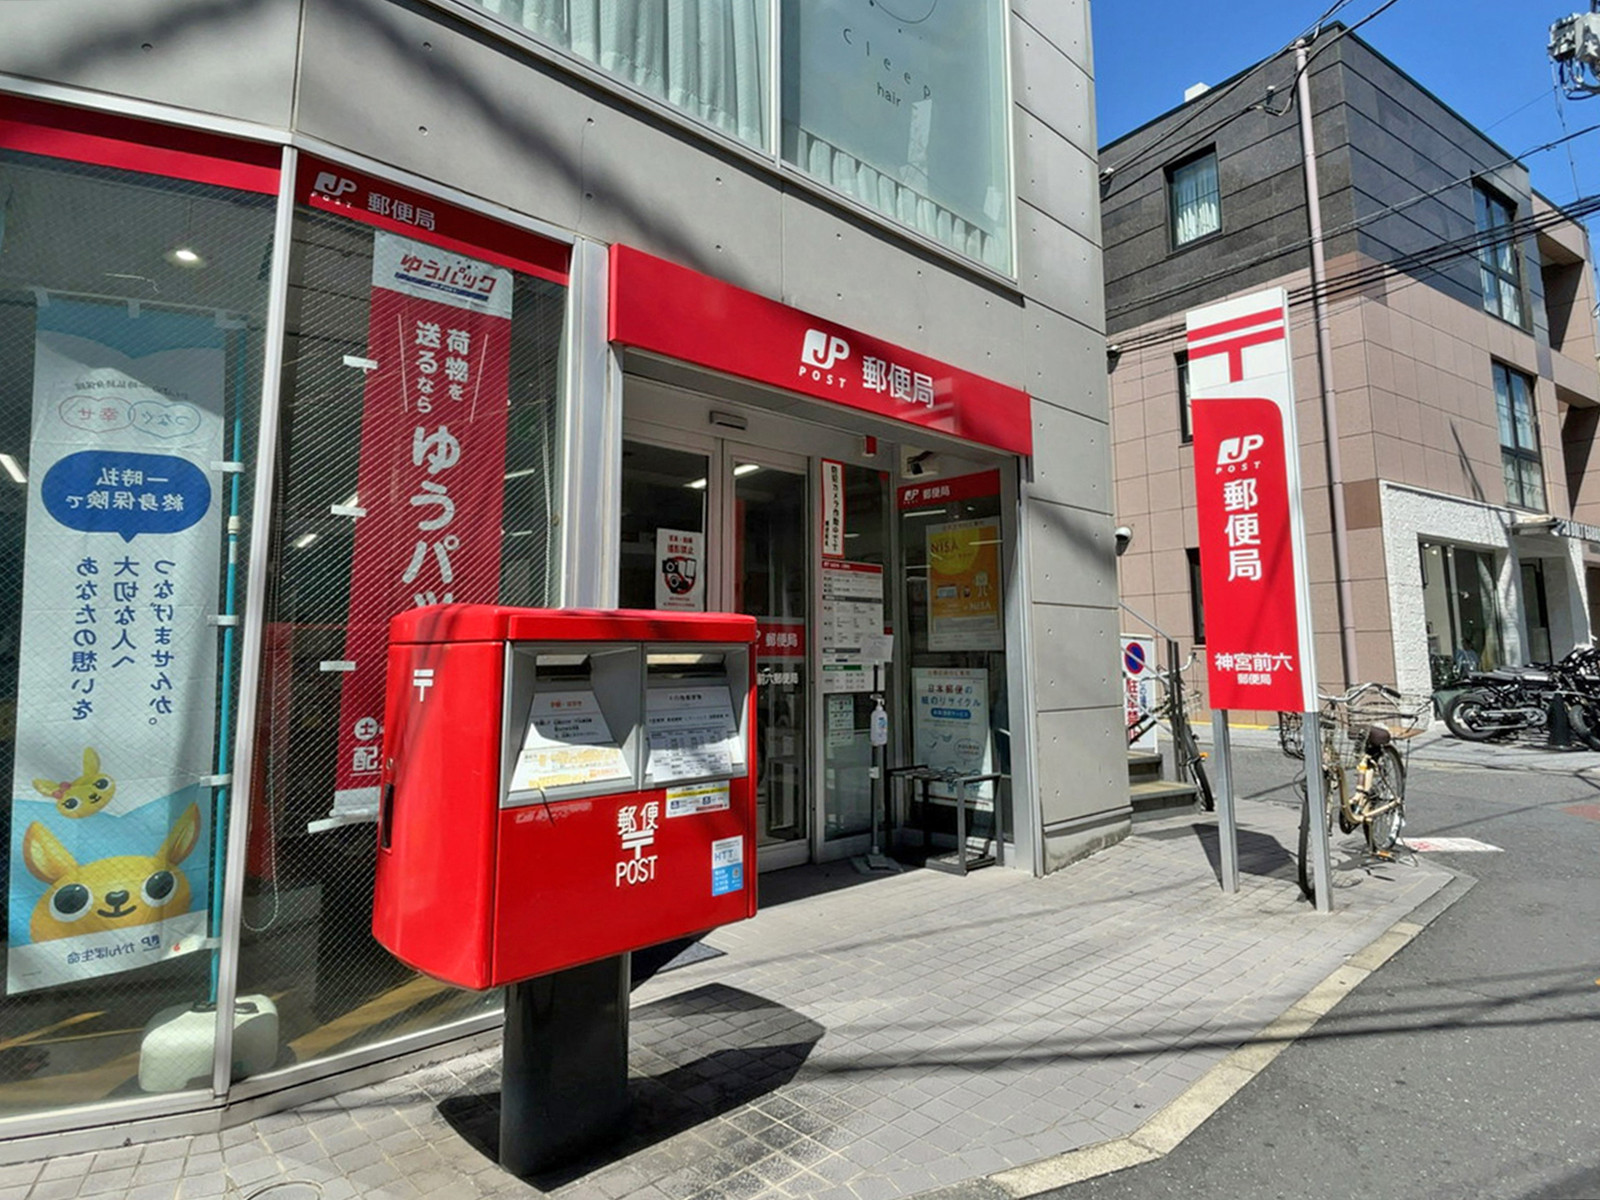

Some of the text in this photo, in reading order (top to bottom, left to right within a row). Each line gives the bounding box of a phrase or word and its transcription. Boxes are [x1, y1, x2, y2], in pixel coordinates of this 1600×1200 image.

[843, 28, 931, 99] cleep
[876, 82, 901, 107] hair
[314, 171, 358, 196] JP
[367, 192, 436, 231] 郵便局
[400, 254, 497, 293] ゆうパック
[801, 328, 850, 369] JP
[415, 320, 441, 413] 送るなら
[445, 329, 471, 401] 荷物を
[799, 366, 846, 388] POST
[862, 355, 934, 408] 郵便局
[1217, 434, 1264, 465] JP
[1215, 461, 1261, 474] POST
[1224, 478, 1262, 582] 郵便局
[765, 632, 798, 647] 郵便局
[1214, 652, 1293, 672] 神宮前六
[928, 684, 972, 694] 日本郵便の
[1237, 673, 1272, 685] 郵便局
[353, 747, 383, 771] 配
[617, 801, 659, 835] 郵便
[616, 855, 658, 887] POST
